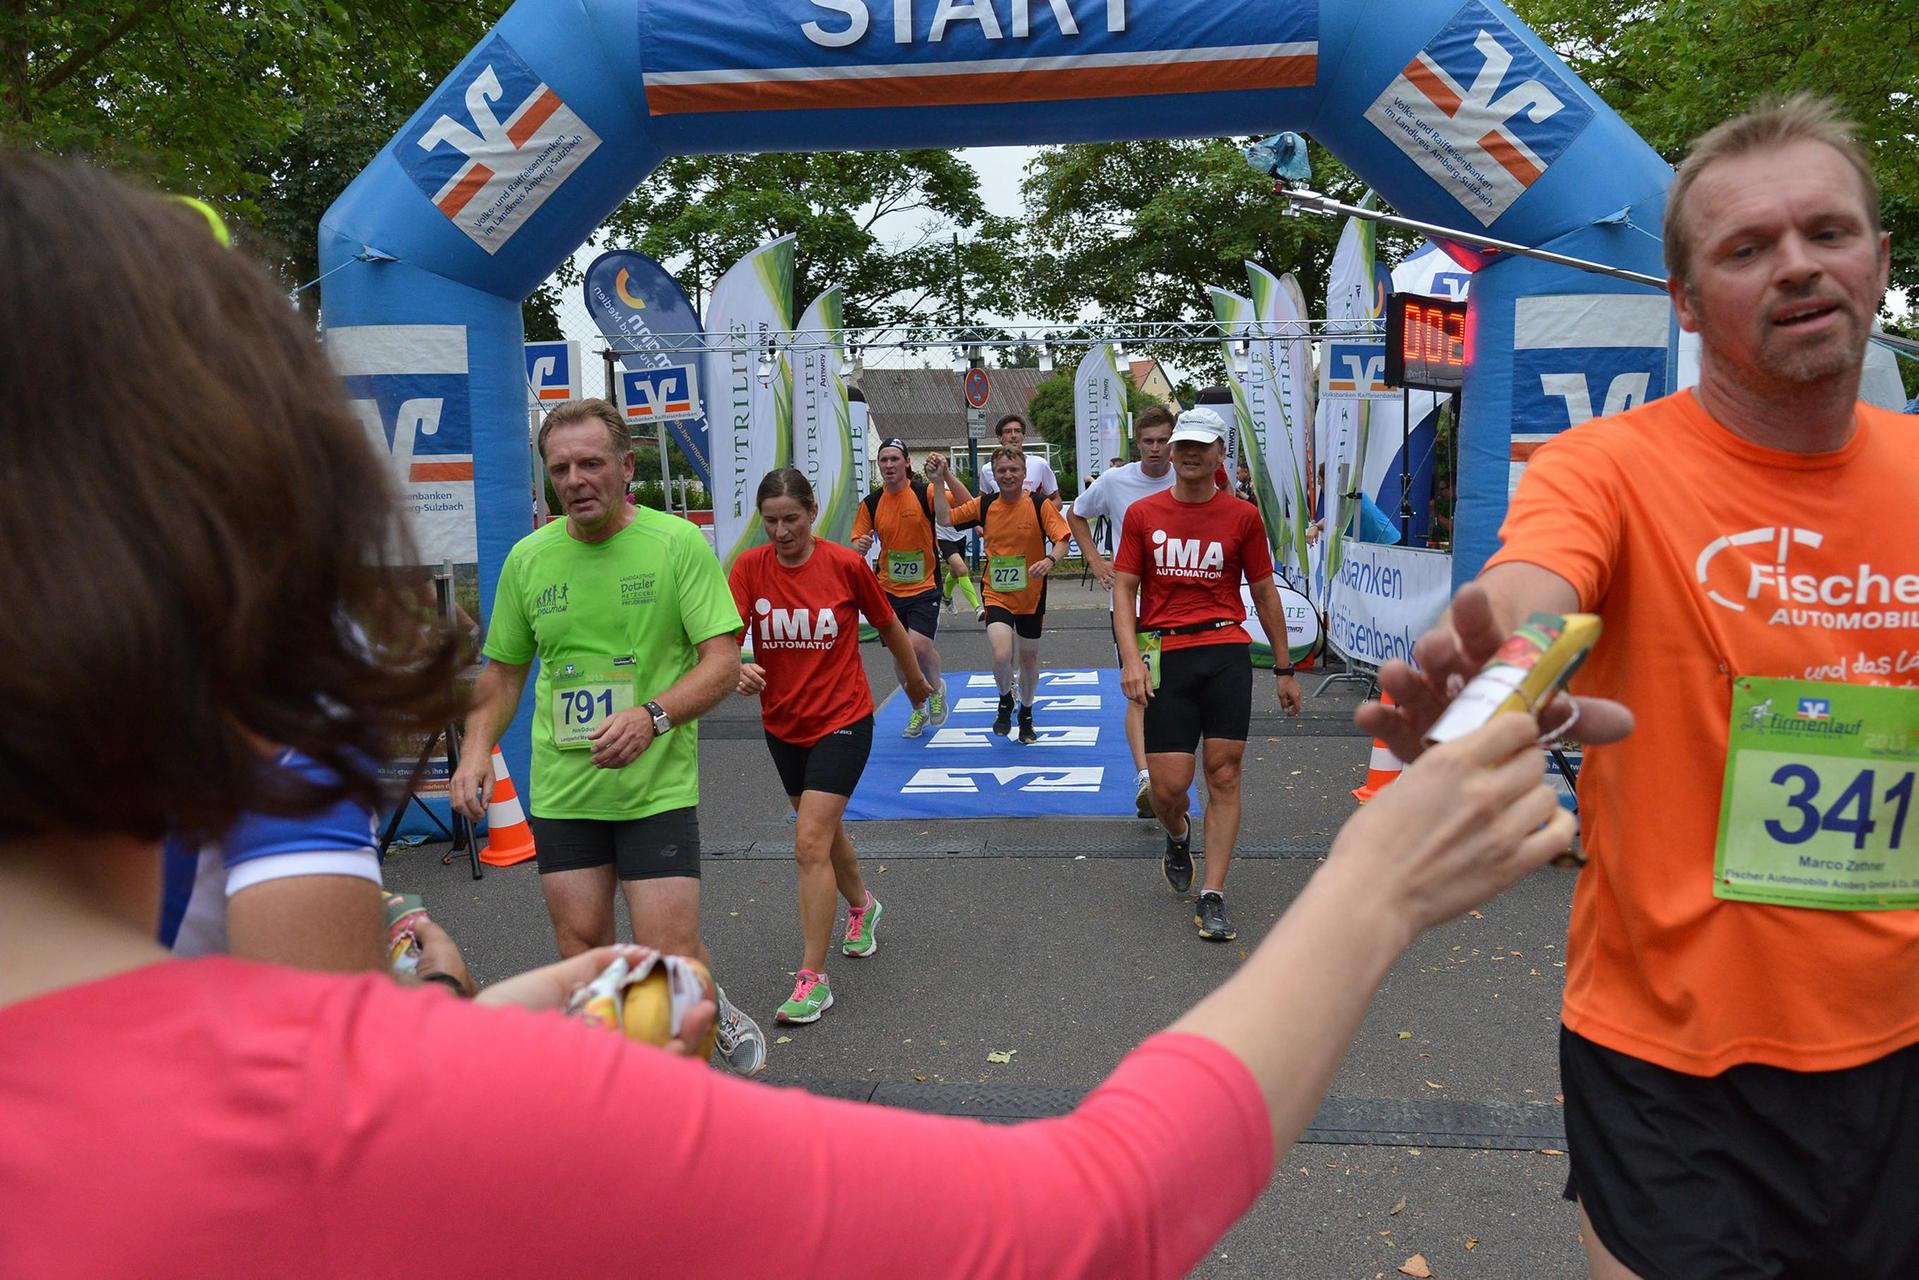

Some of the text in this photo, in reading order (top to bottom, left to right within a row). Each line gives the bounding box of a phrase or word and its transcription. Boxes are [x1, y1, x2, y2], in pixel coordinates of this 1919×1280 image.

[1384, 106, 1493, 208] im Landkreis Amberg-Sulzbach
[1394, 96, 1494, 190] Volks- und Raiffeisenbanken
[474, 134, 566, 228] Volks- und Raiffeisenbanken
[484, 134, 583, 236] im Landkreis Amberg-Sulzbach
[819, 353, 827, 387] Amway
[1088, 377, 1099, 469] NUTRILITE
[1226, 426, 1237, 460] Amway
[893, 562, 918, 575] 279
[994, 568, 1020, 582] 272
[1156, 568, 1222, 580] AUTOMATION
[621, 579, 656, 593] Dotzler
[1286, 625, 1304, 633] mway
[1851, 650, 1892, 675] das
[561, 688, 613, 726] 791
[1763, 763, 1916, 849] 341
[1797, 855, 1844, 871] Marco
